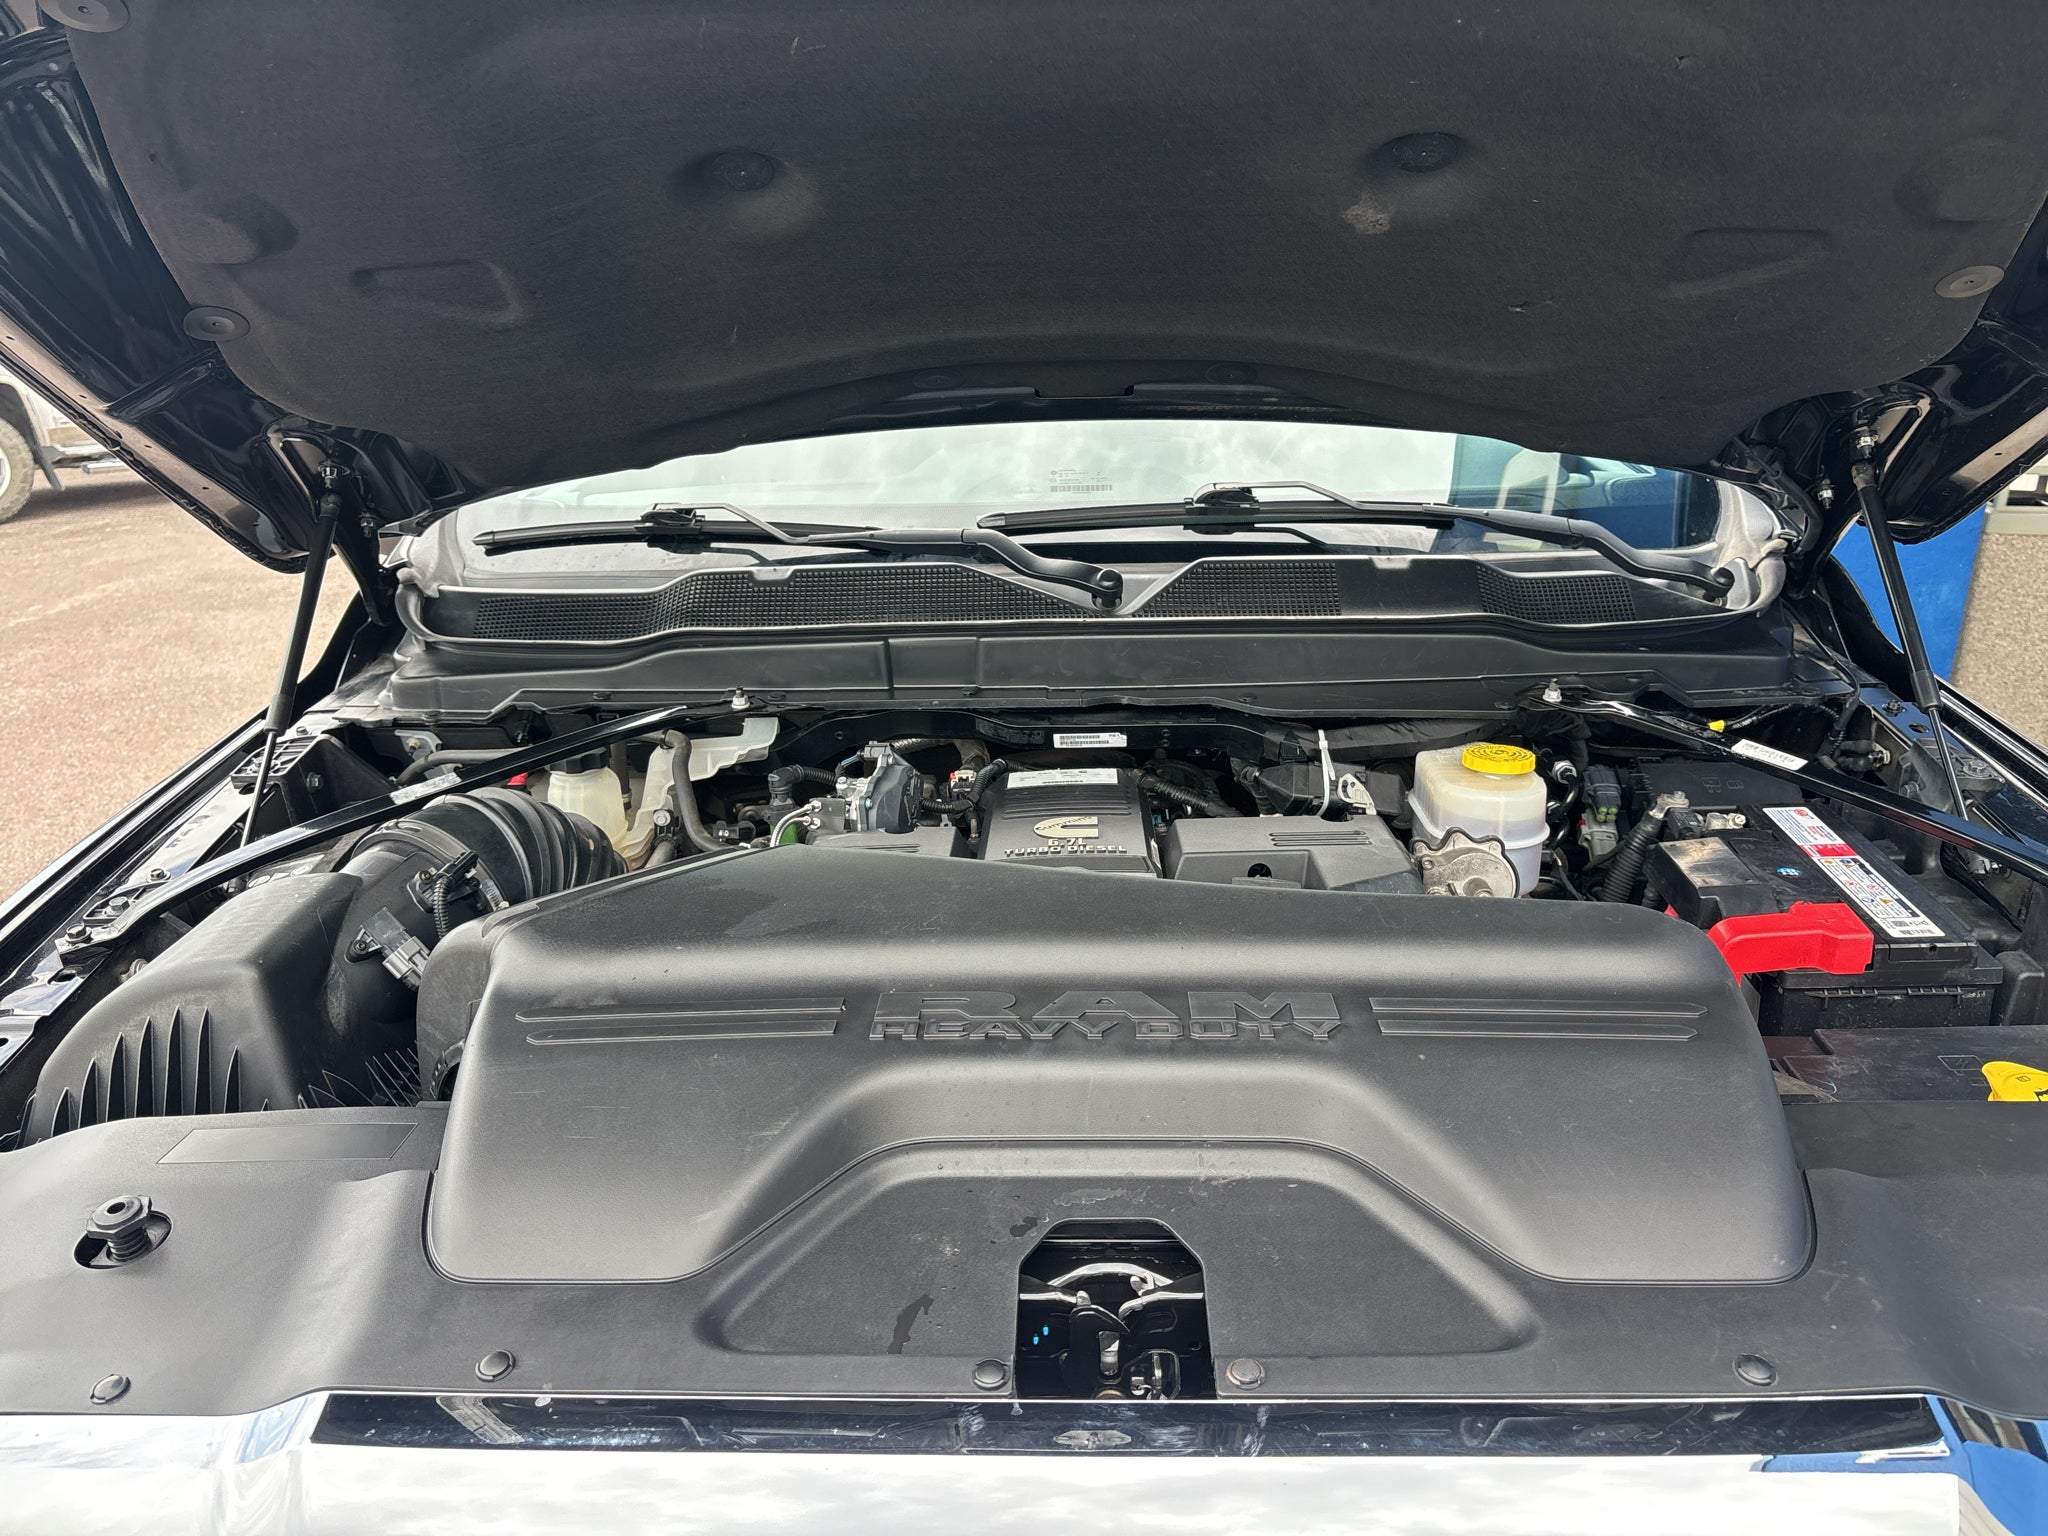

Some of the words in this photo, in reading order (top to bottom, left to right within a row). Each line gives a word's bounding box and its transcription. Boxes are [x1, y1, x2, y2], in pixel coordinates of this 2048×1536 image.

[1034, 816, 1093, 831] Cummins
[1048, 838, 1087, 848] 6.7L
[1004, 845, 1061, 857] TURBO
[1067, 845, 1127, 854] DIESEL
[874, 990, 1340, 1020] RAM
[869, 1020, 1120, 1041] HEAVY
[1136, 1020, 1342, 1041] DUTY
